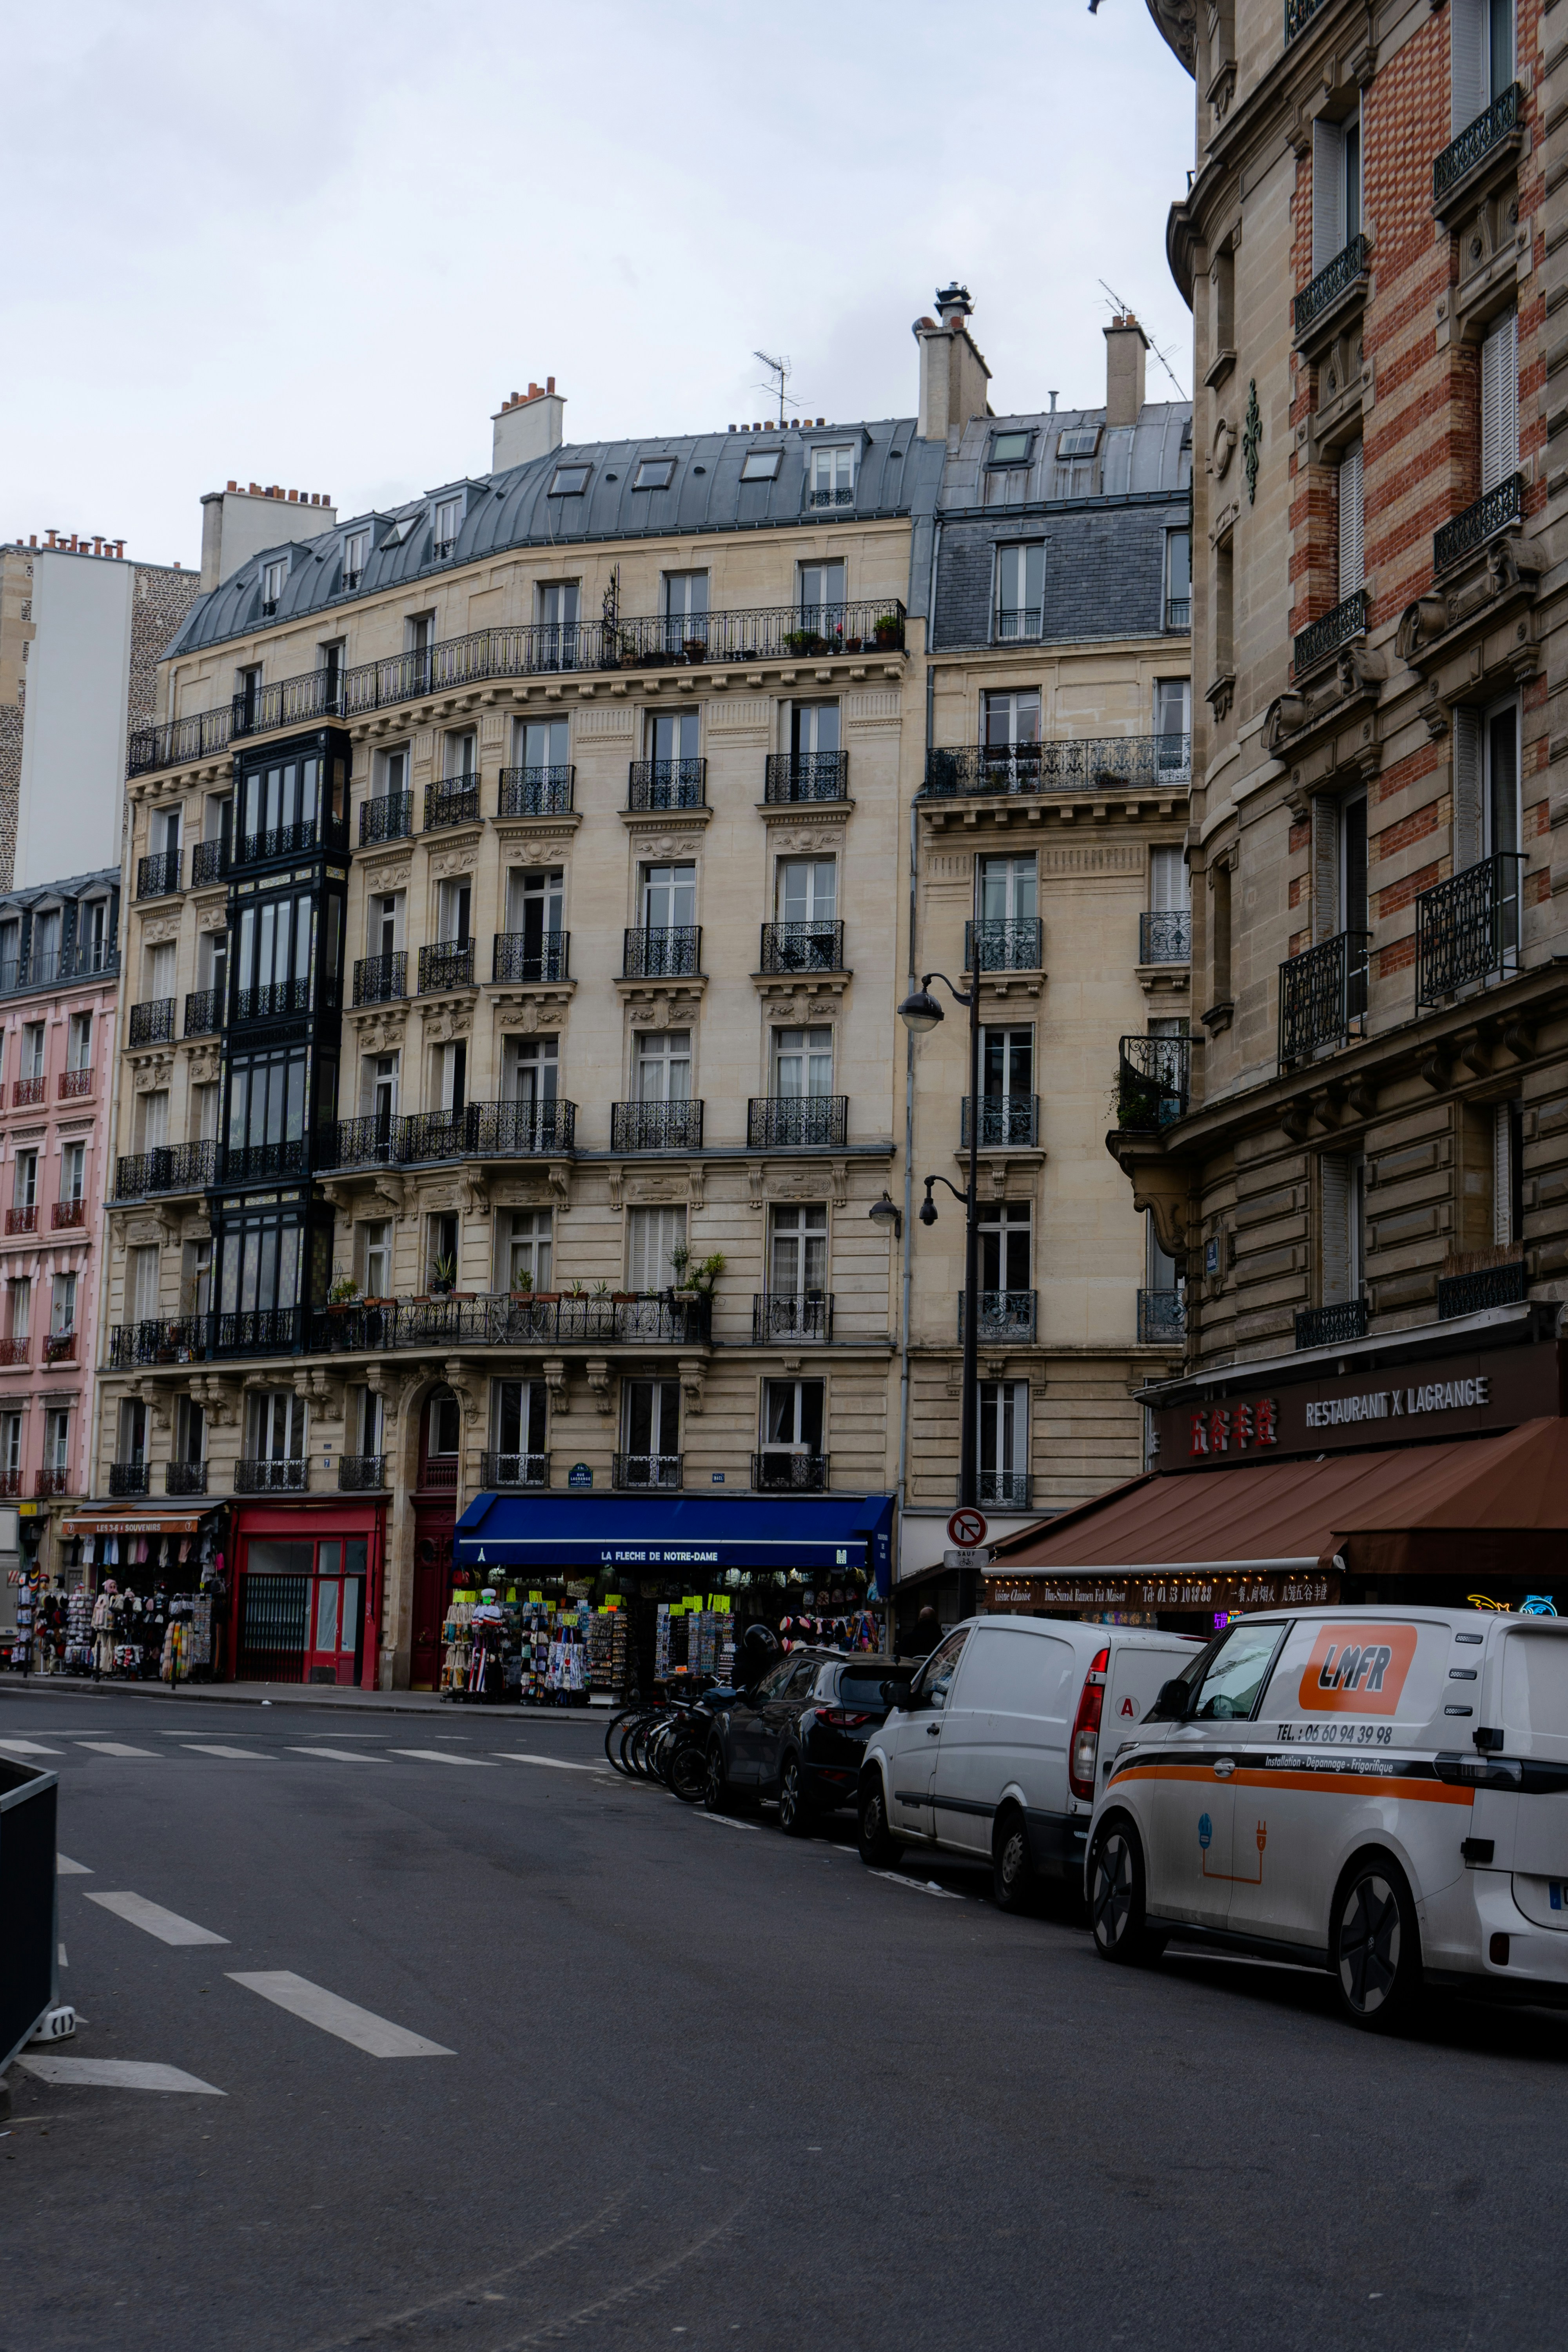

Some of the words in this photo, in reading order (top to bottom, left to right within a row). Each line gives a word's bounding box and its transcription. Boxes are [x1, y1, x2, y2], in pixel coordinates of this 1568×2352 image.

[1306, 1392, 1390, 1427] RESTAURANT
[1392, 1390, 1405, 1416] X
[1408, 1377, 1489, 1414] LAGRANGE
[1189, 1398, 1277, 1455] 五谷丰登
[125, 1523, 161, 1532] SOUVENIRS
[601, 1551, 612, 1561] LA
[615, 1551, 646, 1561] FLECHE
[649, 1552, 661, 1561] DE
[664, 1552, 718, 1561] NOTRE-DAME
[1075, 1588, 1094, 1602] Ramen
[1105, 1588, 1125, 1602] Maison
[1157, 1586, 1167, 1602] 01
[1180, 1586, 1190, 1602] 10
[1191, 1586, 1200, 1602] 88
[1201, 1585, 1212, 1602] 88
[1318, 1644, 1392, 1692] LMFR
[1120, 1698, 1134, 1717] A
[1277, 1724, 1294, 1741] TEL.
[1305, 1724, 1320, 1742] 06
[1322, 1724, 1337, 1742] 60
[1340, 1725, 1355, 1742] 94
[1357, 1726, 1374, 1744] 39
[1377, 1726, 1392, 1745] 98
[1265, 1755, 1301, 1767] Installation
[1306, 1756, 1345, 1772] Dépannage
[1351, 1759, 1393, 1775] Frigorifique
